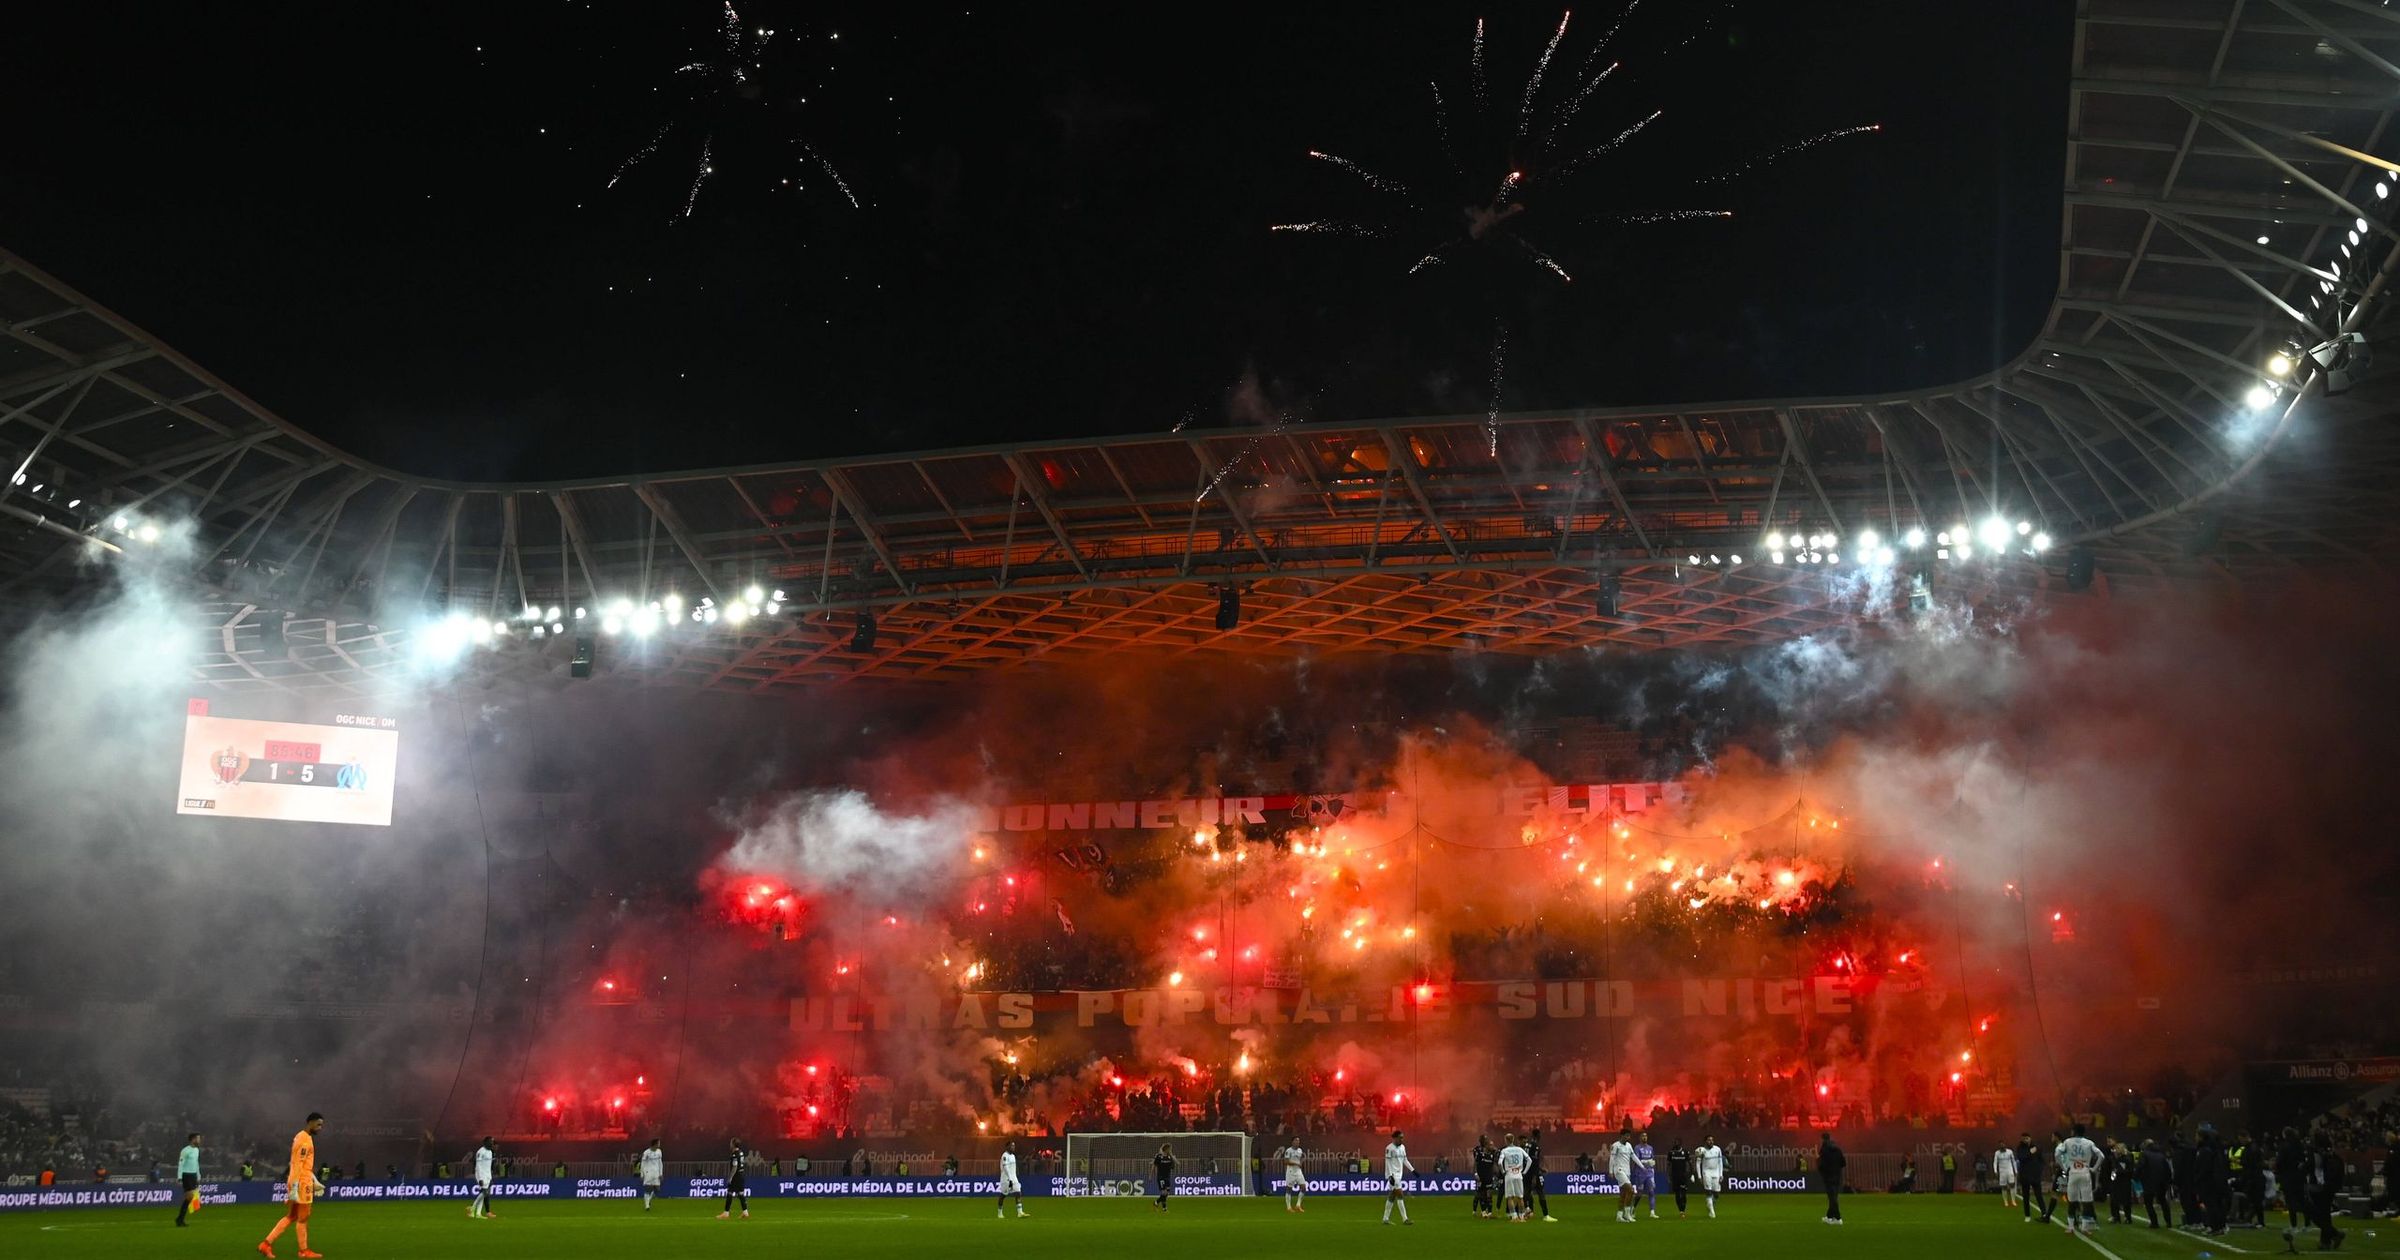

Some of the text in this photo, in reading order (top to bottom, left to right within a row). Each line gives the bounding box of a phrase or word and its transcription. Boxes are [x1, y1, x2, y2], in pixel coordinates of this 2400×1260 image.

[336, 714, 354, 725] OGC
[356, 715, 376, 726] NICE
[382, 717, 395, 727] OM
[269, 763, 279, 780] 1
[301, 764, 314, 783] 5
[789, 993, 1034, 1032] ULTRAS
[1498, 979, 1634, 1019] SUD
[1683, 977, 1852, 1016] NICE
[2289, 1064, 2333, 1078] Allianz
[1301, 1148, 1361, 1162] obinhood
[577, 1179, 611, 1188] GROUPE
[690, 1178, 724, 1187] GROUPE
[1051, 1177, 1088, 1185] GROUPE
[1174, 1176, 1211, 1185] GROUPE
[1420, 1180, 1438, 1191] LA
[1441, 1175, 1476, 1190] CÔTE
[1566, 1174, 1606, 1183] GROUPE
[1728, 1177, 1806, 1191] Robinhood
[340, 1186, 383, 1197] GROUPE
[385, 1181, 429, 1197] MÉDIA
[433, 1185, 451, 1197] DE
[452, 1185, 469, 1196] LA
[471, 1184, 503, 1196] CTE
[504, 1183, 550, 1195] D'AZUR
[797, 1183, 849, 1194] GROUPE
[851, 1178, 893, 1194] MÉDIA
[896, 1182, 914, 1193] DE
[916, 1182, 934, 1193] LA
[936, 1177, 971, 1193] CÔTE
[974, 1182, 1001, 1193] D'AZ
[1174, 1184, 1241, 1196] nice-matin
[1566, 1183, 1638, 1194] nice-man
[38, 1188, 74, 1205] MÉDIA
[76, 1191, 92, 1204] DE
[93, 1191, 107, 1203] LA
[108, 1187, 135, 1203] CÔTE
[136, 1189, 173, 1202] D'AZUR
[576, 1187, 637, 1198] nice-matin
